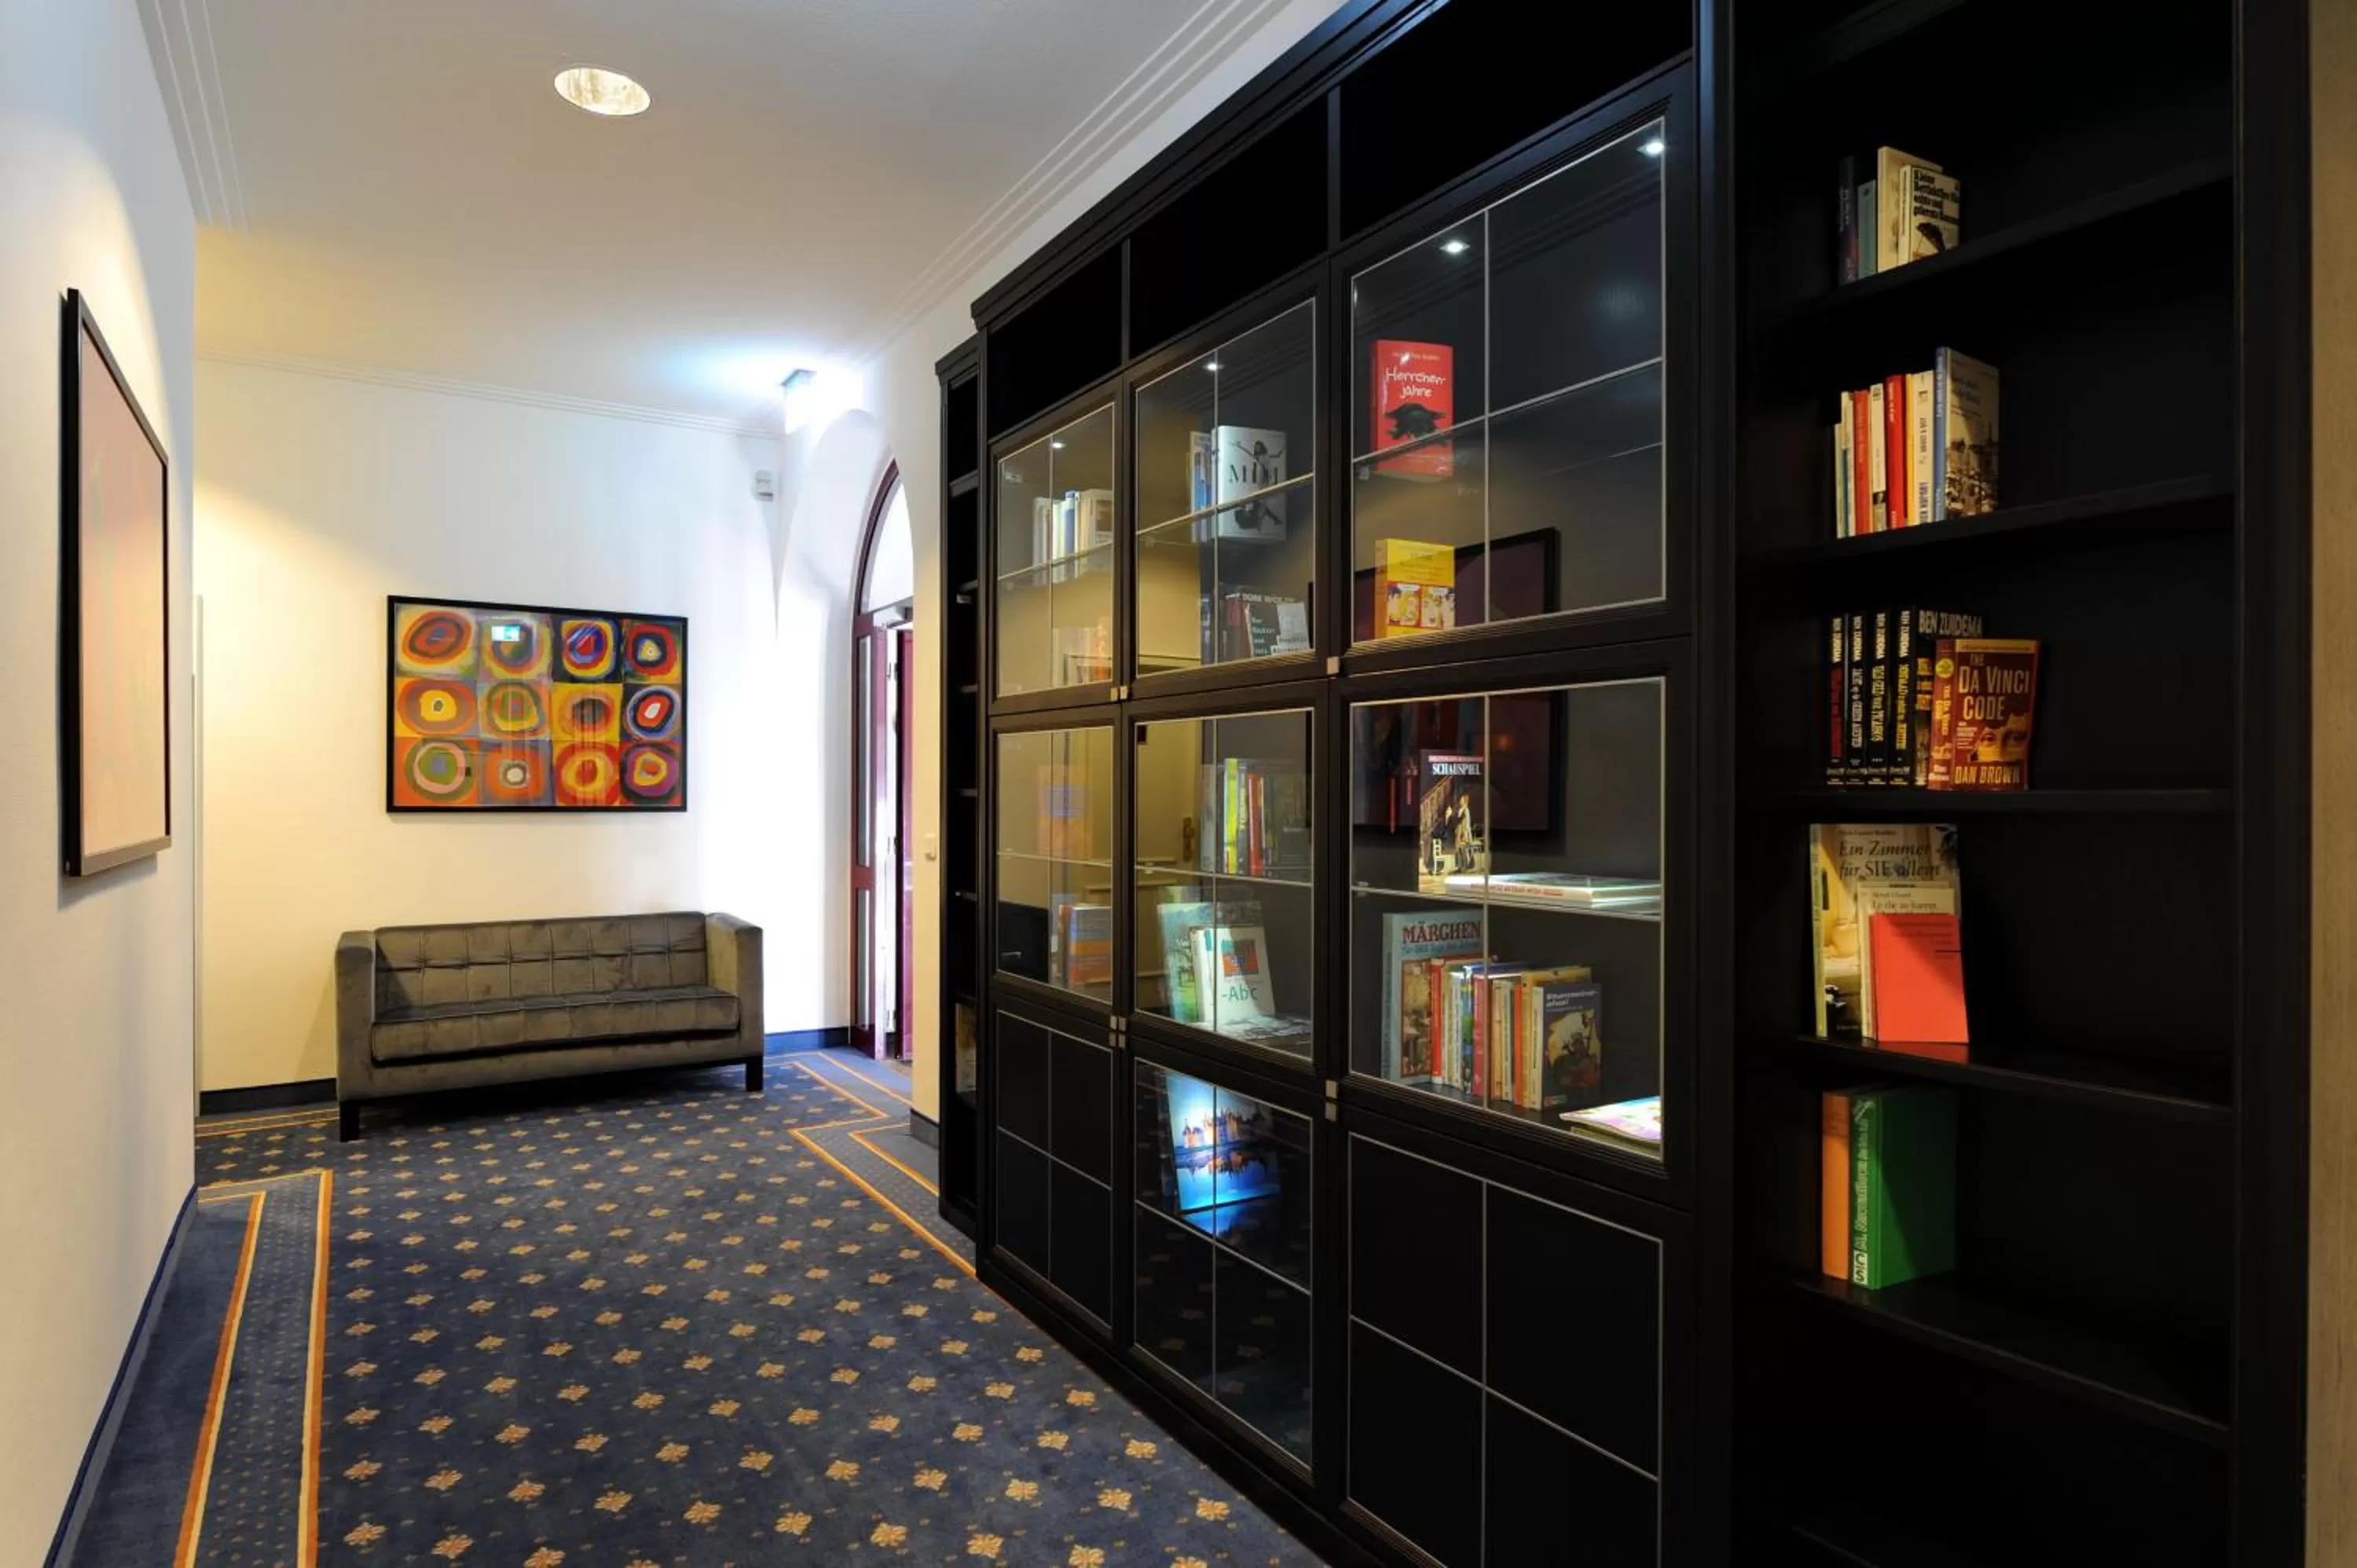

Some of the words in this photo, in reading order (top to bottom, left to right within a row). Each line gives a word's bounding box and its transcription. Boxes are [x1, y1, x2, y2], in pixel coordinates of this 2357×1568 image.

[1919, 610, 1938, 634] BEN
[1970, 653, 1985, 667] THE
[1958, 666, 1981, 694] DA
[1986, 666, 2030, 694] VINCI
[1963, 695, 2005, 720] CODE
[1954, 765, 1977, 785] DAN
[1979, 765, 2021, 785] BROWN
[1838, 840, 1864, 857] Ein
[1868, 840, 1930, 857] Zimmer
[1838, 860, 1860, 881] für
[1865, 860, 1893, 877] SIE
[1402, 921, 1481, 943] MÄRCHEN
